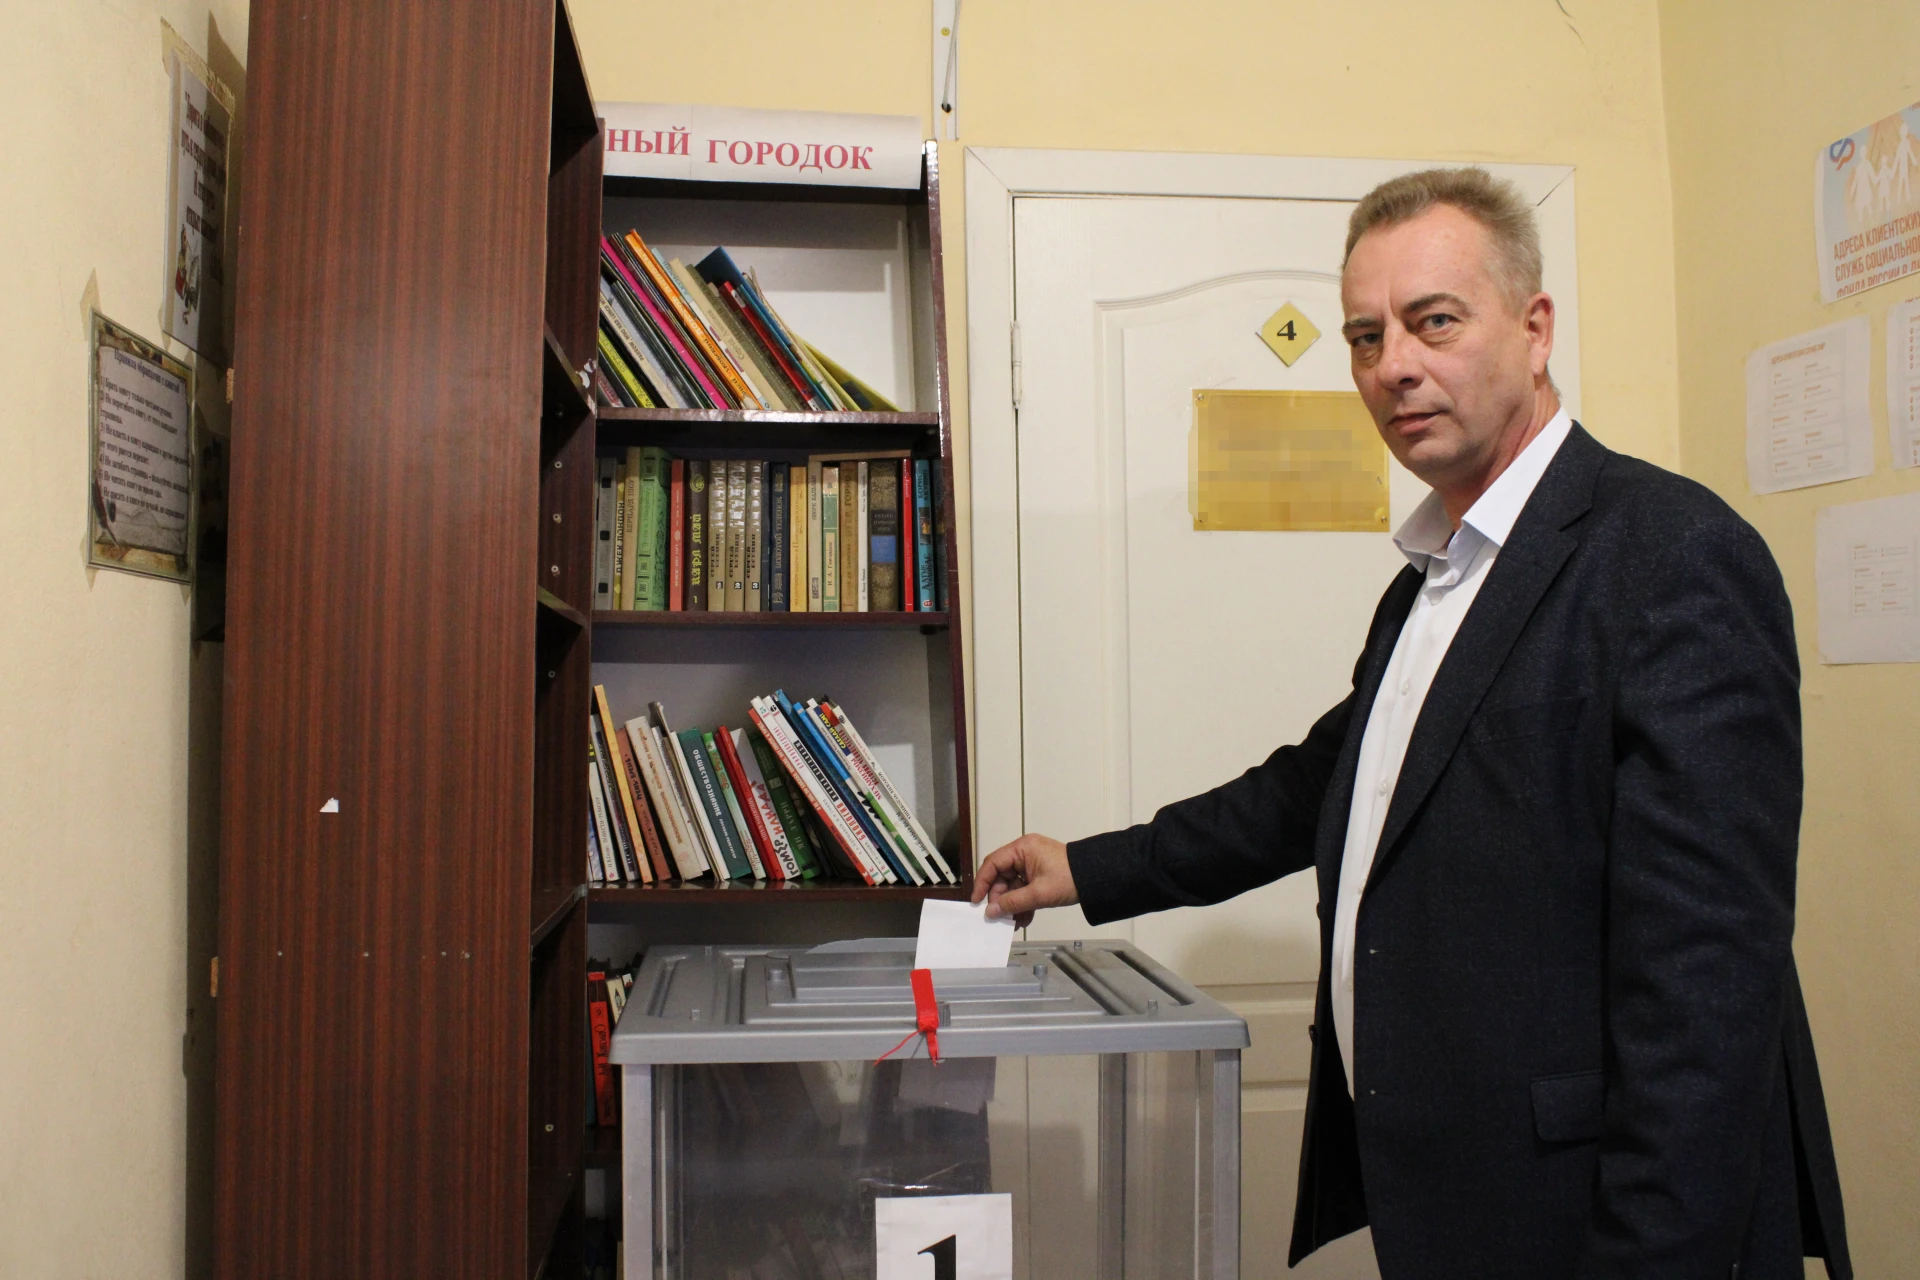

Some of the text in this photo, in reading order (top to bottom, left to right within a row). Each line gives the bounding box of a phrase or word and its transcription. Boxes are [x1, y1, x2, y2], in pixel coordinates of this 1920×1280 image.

[606, 126, 874, 174] НЫЙ ГОРОДОК
[1834, 233, 1865, 260] АДРЕСА
[1835, 257, 1864, 282] СЛУЖБ
[1276, 320, 1296, 341] 4
[626, 479, 635, 533] БЕРНАРД ШОУ
[615, 502, 625, 574] ДЖЕК ЛОНДОН
[818, 712, 833, 728] САМ!
[827, 725, 848, 751] СДЕЛАЙ
[692, 748, 723, 818] ОБЩЕСТВОЗНАНИЕ
[850, 756, 884, 802] МЕХАНИЗМЫ
[752, 783, 785, 837] ИЛИАДА
[780, 801, 805, 851] ЯН ЛАРРИ
[836, 801, 867, 842] БИОЛОГИЯ
